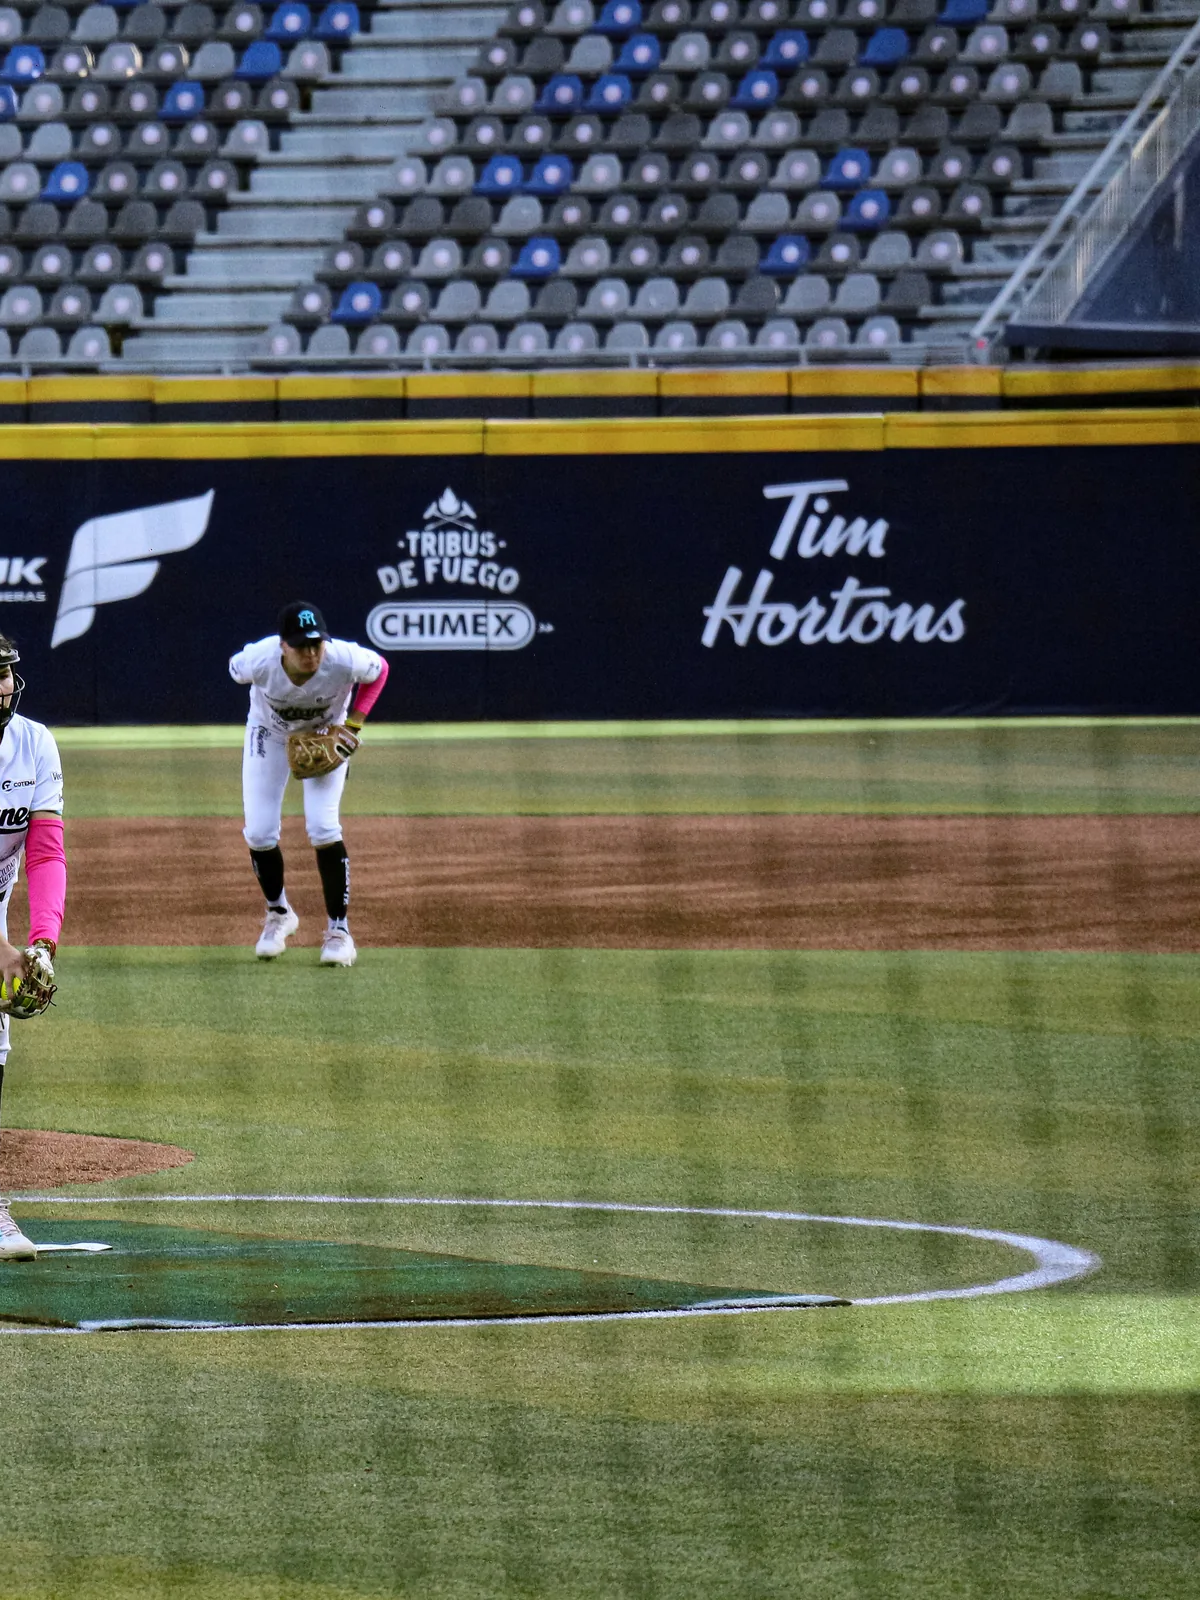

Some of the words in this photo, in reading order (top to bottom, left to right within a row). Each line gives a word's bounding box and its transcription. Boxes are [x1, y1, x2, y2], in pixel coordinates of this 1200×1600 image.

[763, 480, 889, 560] Tim
[406, 531, 497, 557] TRIBUS
[377, 560, 418, 594] DE
[424, 557, 520, 594] FUEGO
[381, 614, 516, 637] CHIMEX
[701, 566, 967, 648] Hortons
